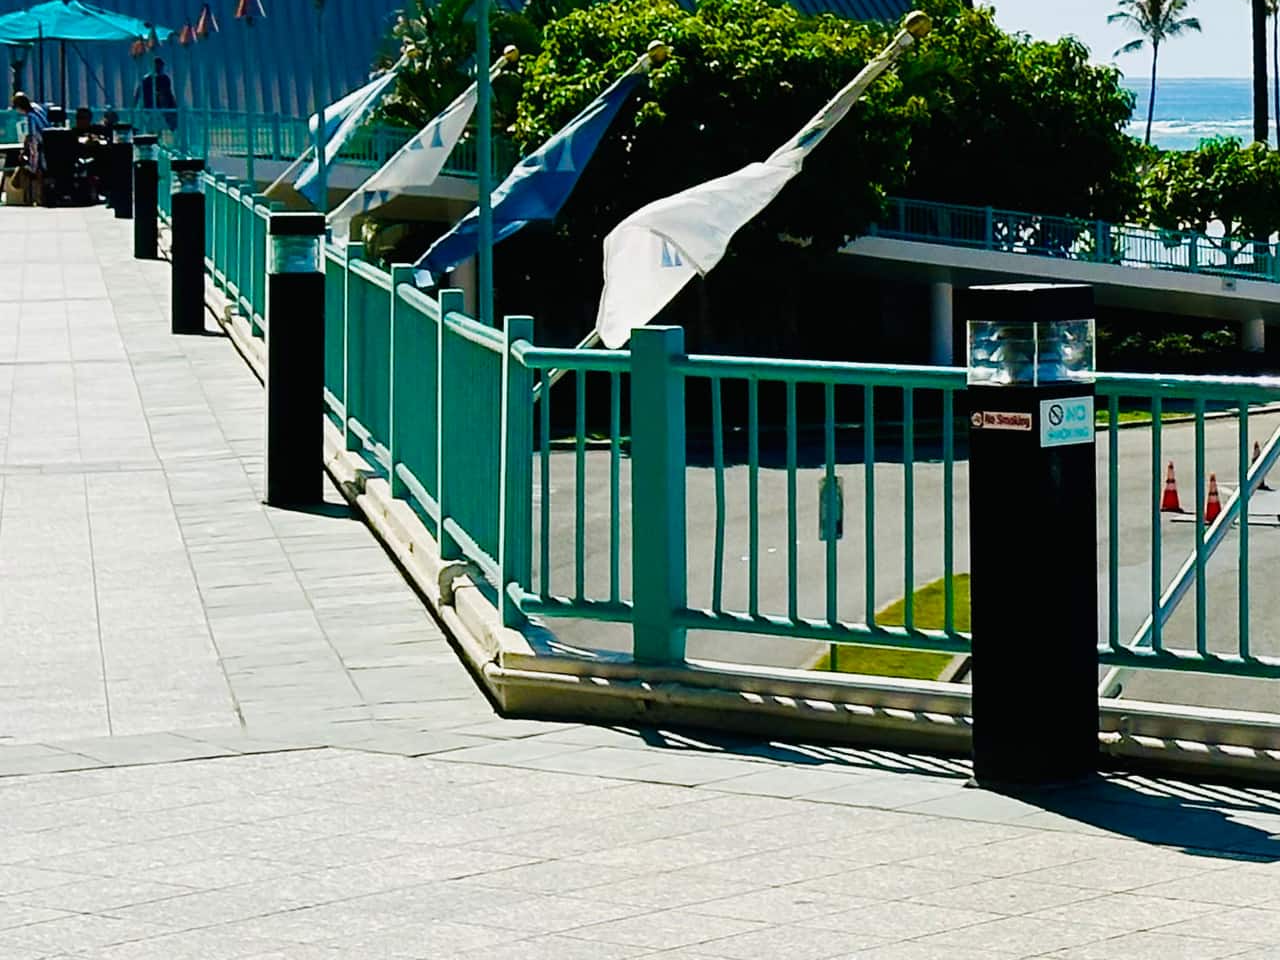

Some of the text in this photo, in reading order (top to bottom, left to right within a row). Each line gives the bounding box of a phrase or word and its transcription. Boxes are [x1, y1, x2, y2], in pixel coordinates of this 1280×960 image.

[985, 414, 1030, 428] No Smoking
[1066, 405, 1086, 422] NO
